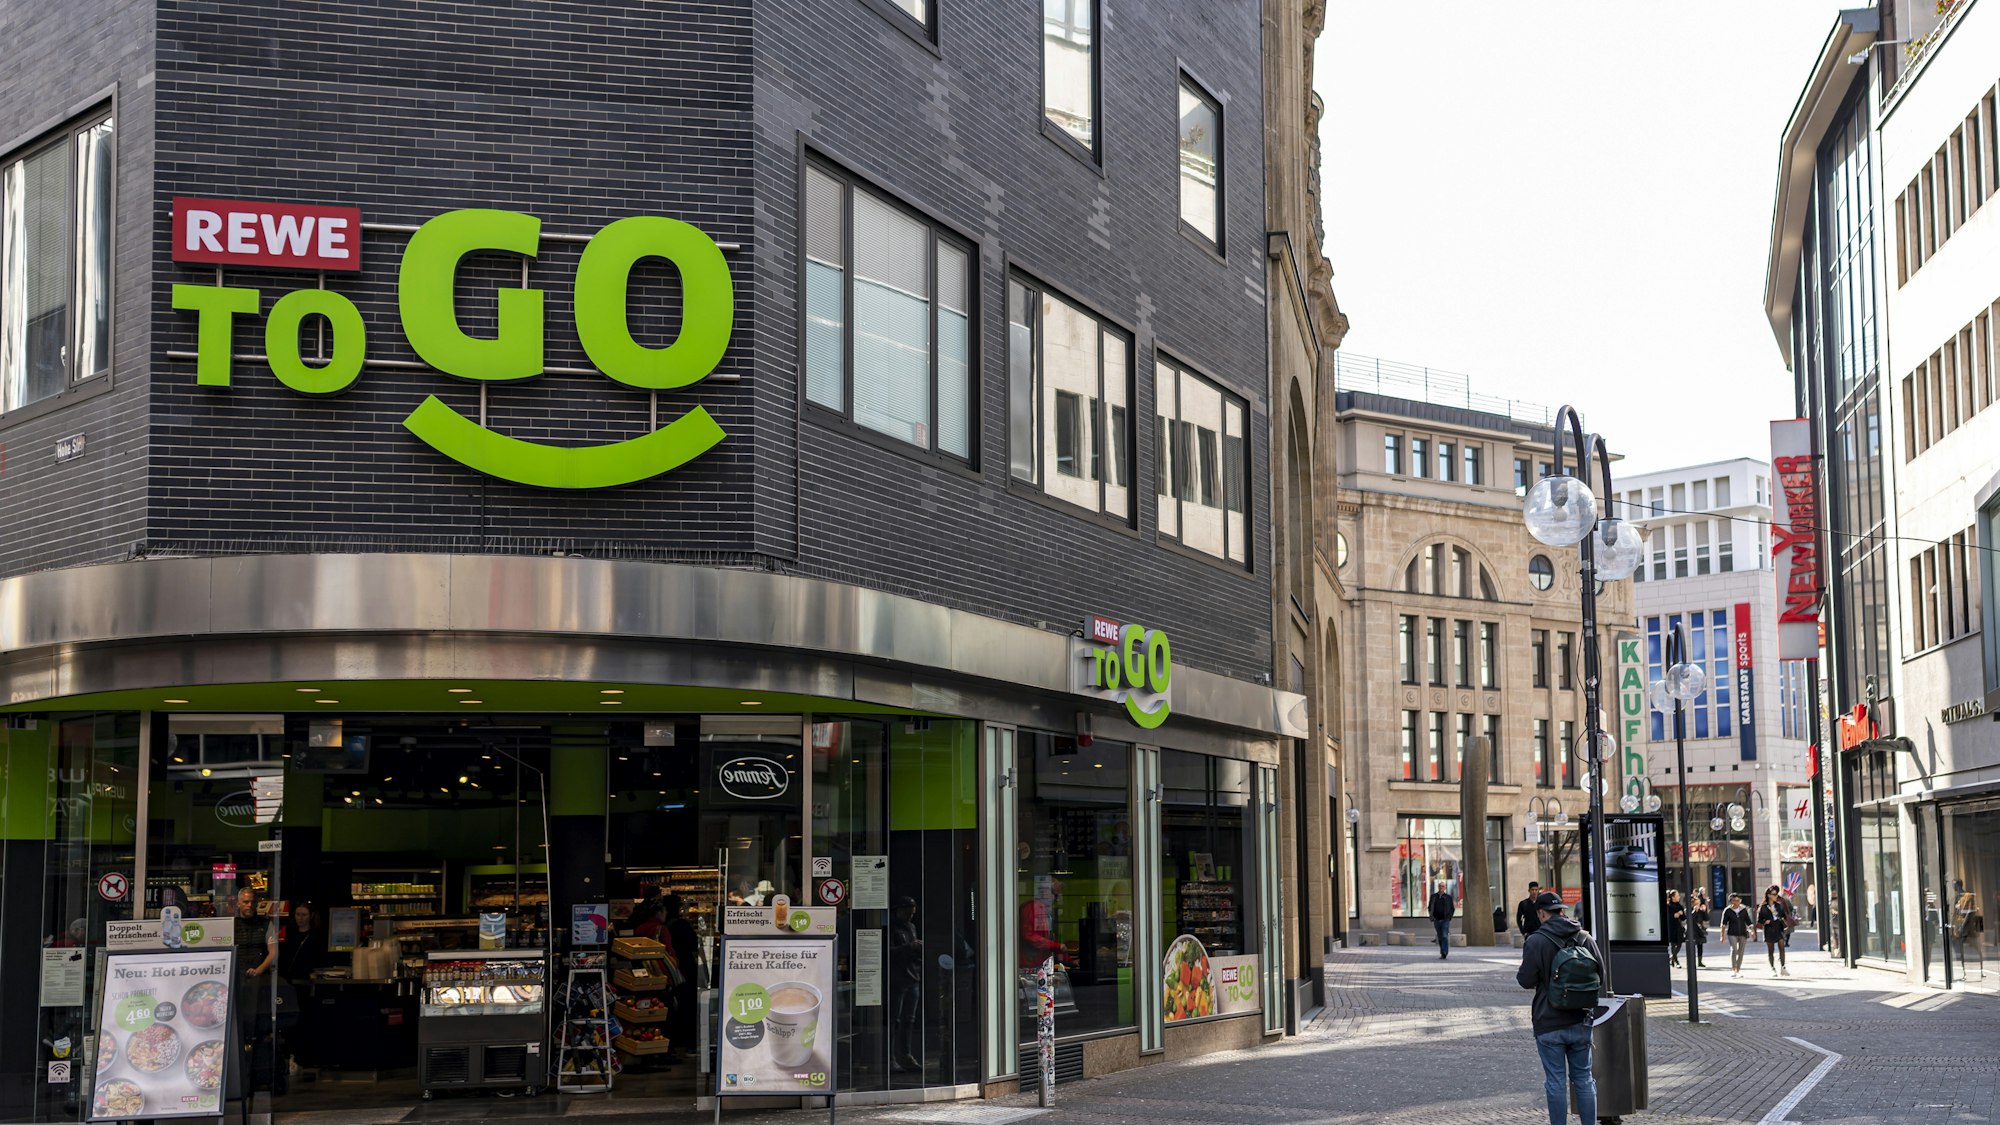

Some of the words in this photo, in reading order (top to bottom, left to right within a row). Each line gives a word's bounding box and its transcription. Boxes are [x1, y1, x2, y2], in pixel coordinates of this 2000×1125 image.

[186, 209, 349, 259] REWE
[172, 283, 366, 394] TO
[398, 208, 734, 389] GO
[1094, 619, 1119, 641] REWE
[1737, 632, 1751, 666] sports
[1092, 647, 1120, 690] TO
[1123, 623, 1171, 694] GO
[1740, 668, 1751, 725] KARSTADT
[109, 924, 142, 933] Doppelt
[109, 931, 160, 939] erfrischend.
[729, 951, 759, 959] Faire
[762, 950, 798, 959] Preise
[801, 950, 818, 959] für
[114, 969, 147, 979] Neu:
[152, 966, 176, 977] Hot
[180, 964, 226, 976] Bowls!
[728, 961, 763, 970] fairen
[765, 961, 807, 970] Kaffee.
[1222, 970, 1237, 981] REWE
[1228, 985, 1239, 1002] TO
[1239, 964, 1254, 987] GO
[810, 1072, 826, 1081] GO
